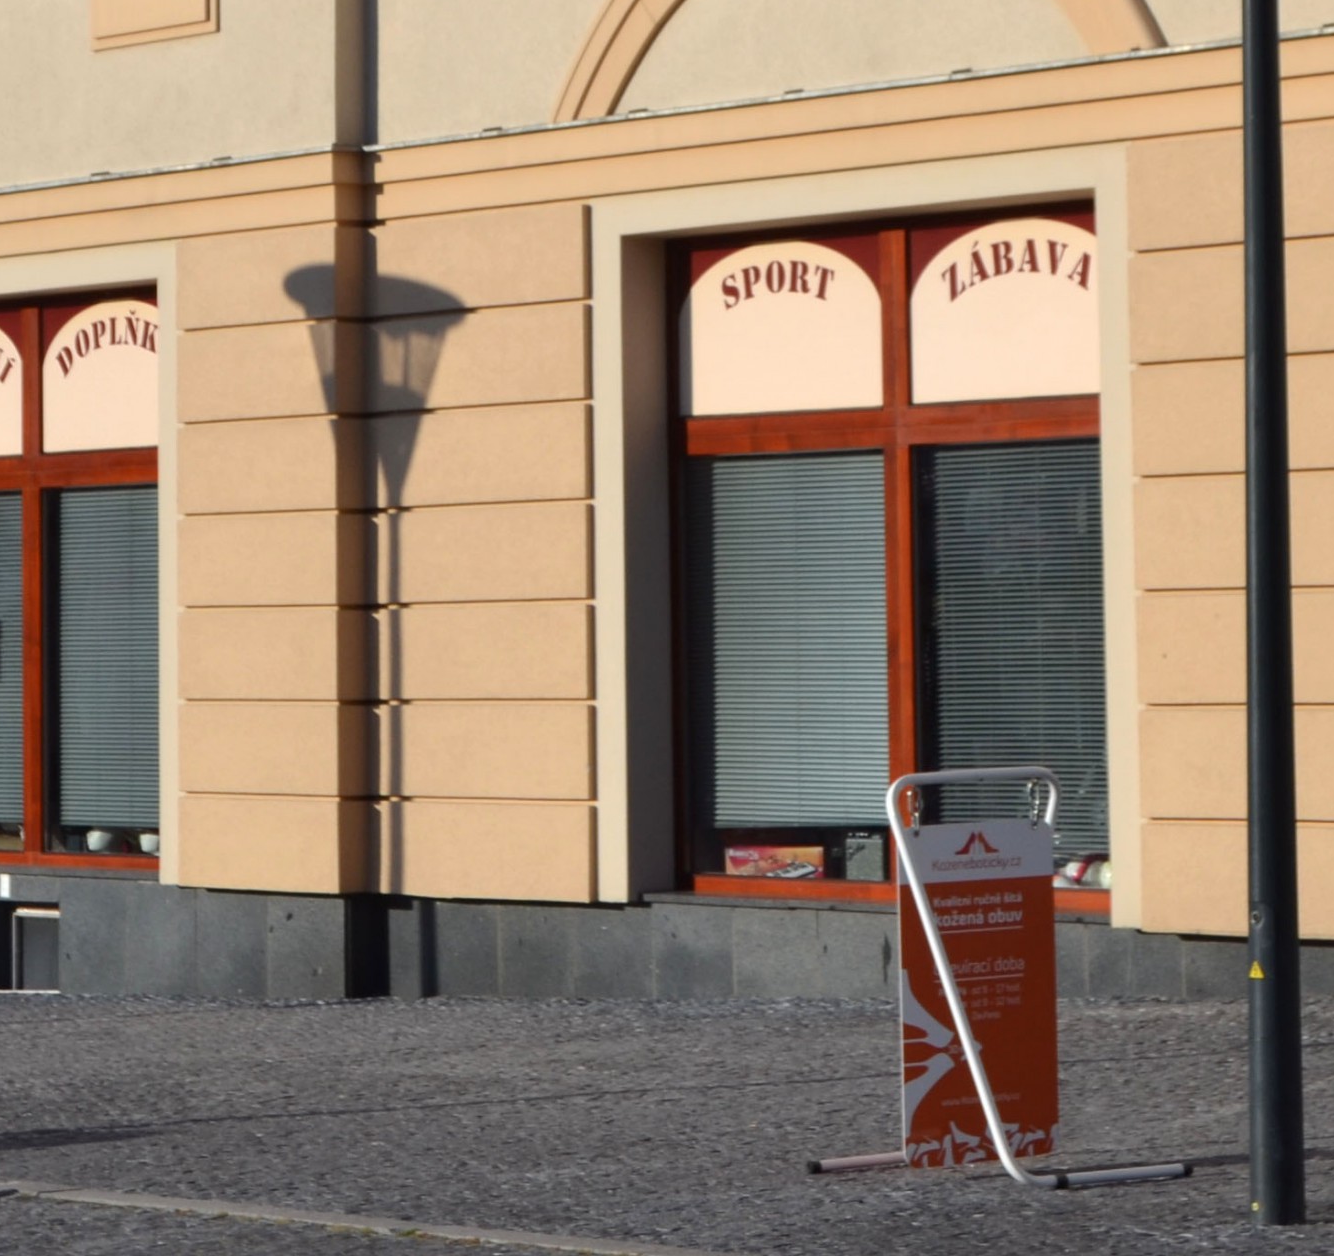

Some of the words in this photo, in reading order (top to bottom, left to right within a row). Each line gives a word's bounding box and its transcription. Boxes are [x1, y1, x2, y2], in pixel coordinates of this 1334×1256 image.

[720, 259, 835, 311] SPORT
[940, 238, 1092, 303] ZÁBAVA
[55, 308, 158, 378] DOPLŇK
[987, 907, 1023, 923] obuv
[994, 956, 1025, 972] doba
